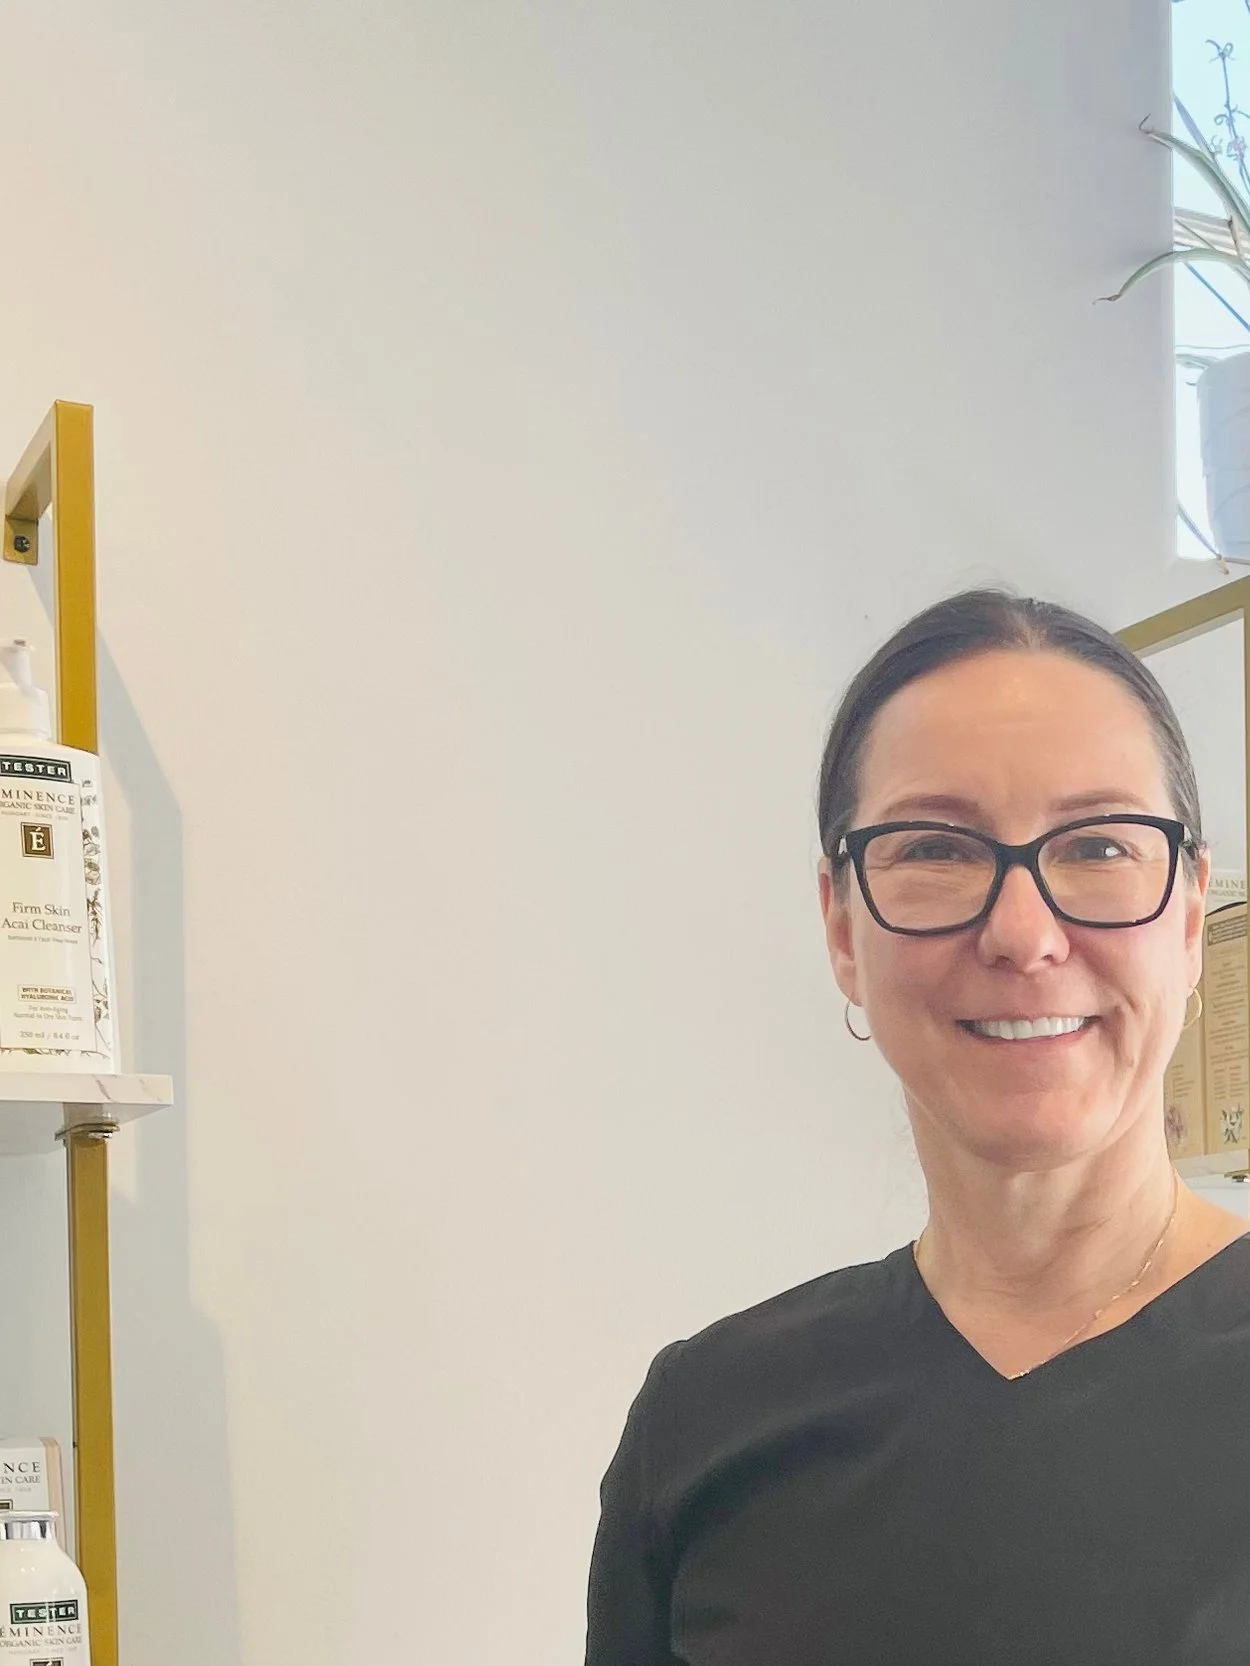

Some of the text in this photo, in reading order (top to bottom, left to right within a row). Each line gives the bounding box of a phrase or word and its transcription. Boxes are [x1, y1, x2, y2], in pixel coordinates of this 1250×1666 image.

[1, 761, 67, 777] TESTER
[1, 788, 76, 806] MINENCE
[29, 826, 46, 851] É
[12, 901, 71, 917] Firm Skin
[32, 919, 82, 934] Cleanser
[16, 1606, 75, 1619] TESTER
